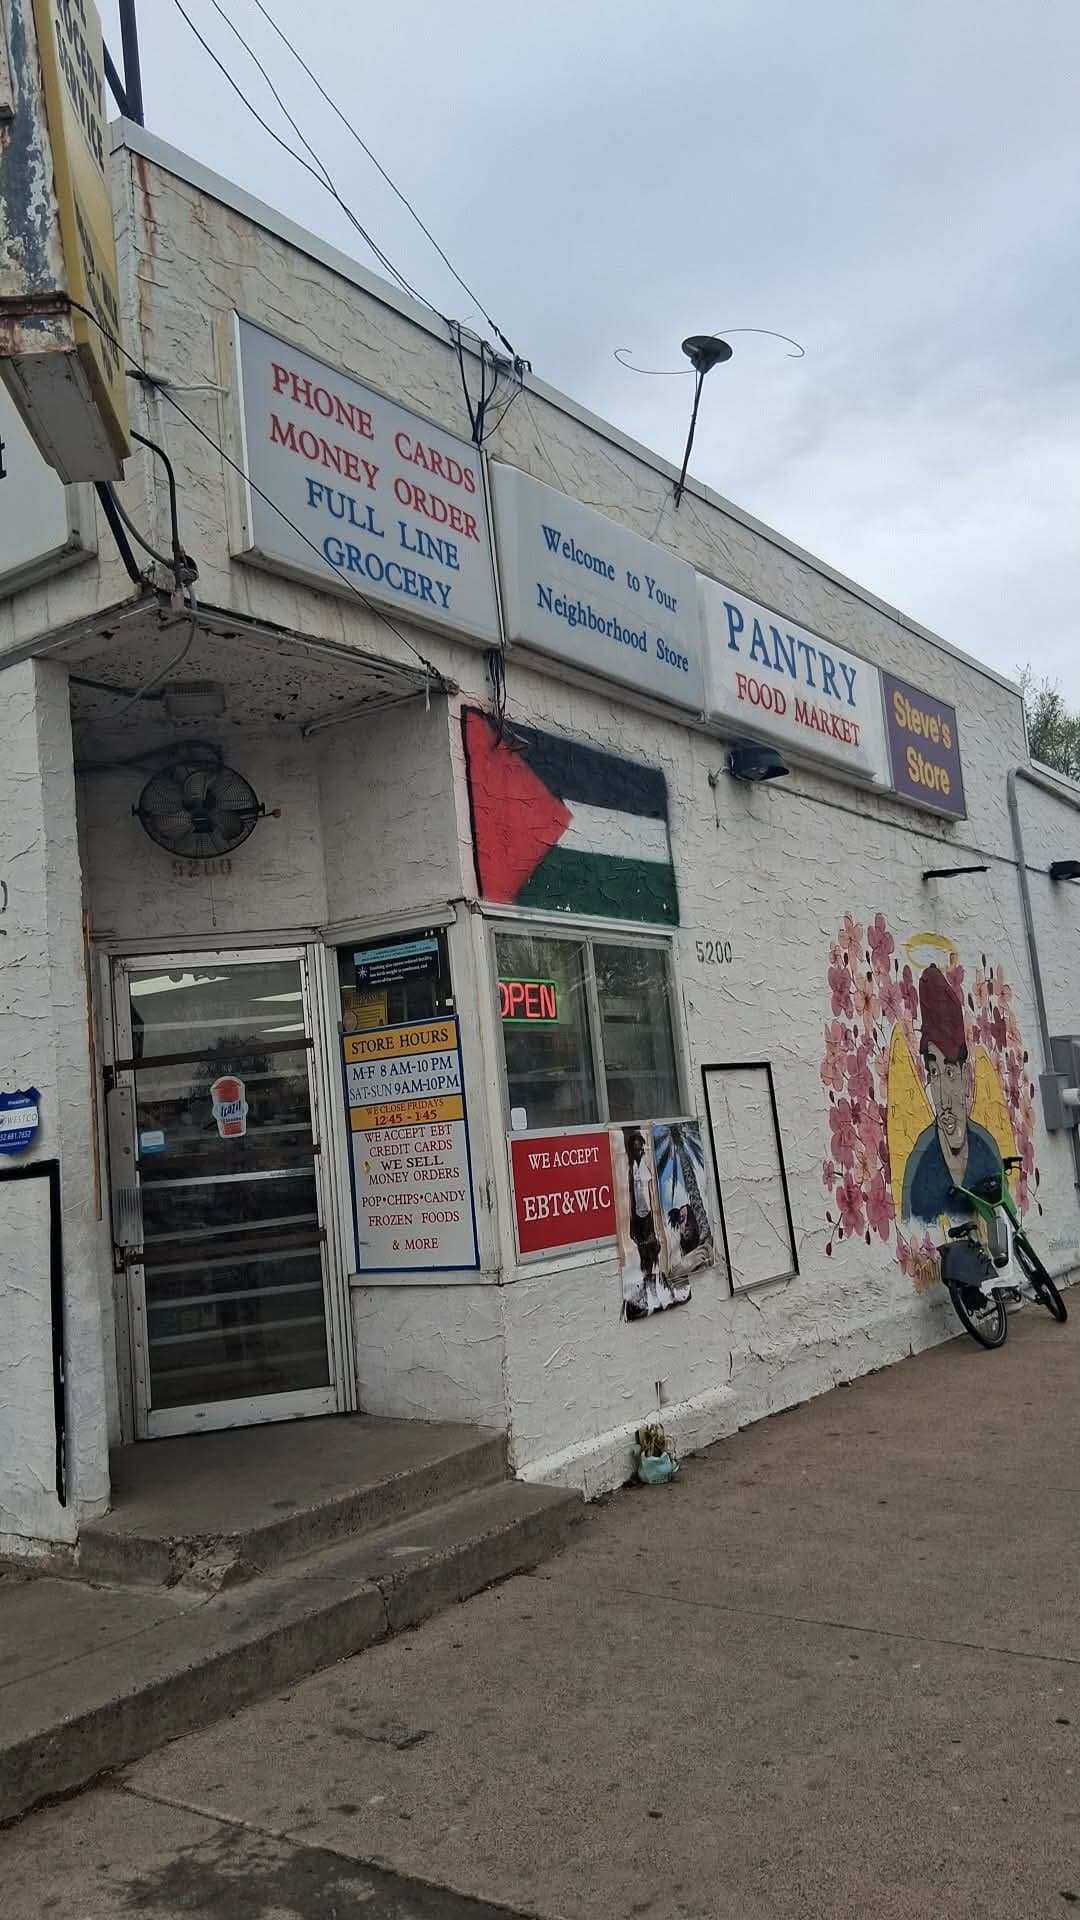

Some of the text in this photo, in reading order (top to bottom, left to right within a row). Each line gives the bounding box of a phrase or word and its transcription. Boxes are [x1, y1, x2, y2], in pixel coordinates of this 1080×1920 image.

[55, 19, 105, 174] SERVICE
[271, 362, 475, 494] PHONE CARDS
[270, 414, 480, 543] MONEY ORDER
[305, 477, 460, 571] FULL LINE
[323, 536, 452, 609] GROCERY
[541, 524, 677, 613] Welcome to Your
[536, 582, 689, 672] Neighborhood Store
[723, 601, 857, 707] PANTRY
[735, 672, 860, 747] FOOD MARKET
[893, 690, 951, 749] Steve's
[906, 746, 951, 796] Store
[695, 940, 732, 964] 5200
[497, 982, 556, 1018] OPEN
[352, 1028, 448, 1056] STORE HOURS
[353, 1065, 375, 1081] M-F
[380, 1064, 387, 1077] 8
[431, 1055, 453, 1070] PM
[349, 1083, 392, 1102] SAT-SUN
[366, 1098, 444, 1115] WE CLOSE FRIDAYS
[364, 1124, 453, 1143] WE ACCEPT EBT
[375, 1113, 403, 1127] 12:45
[369, 1139, 453, 1158] CREDIT CARDS
[381, 1155, 444, 1171] WE SELL
[528, 1147, 599, 1170] WE ACCEPT
[368, 1167, 459, 1186] MONEY ORDERS
[368, 1211, 460, 1227] FROZEN FOODS
[523, 1185, 612, 1222] EBT&WIC
[392, 1237, 439, 1251] & MORE
